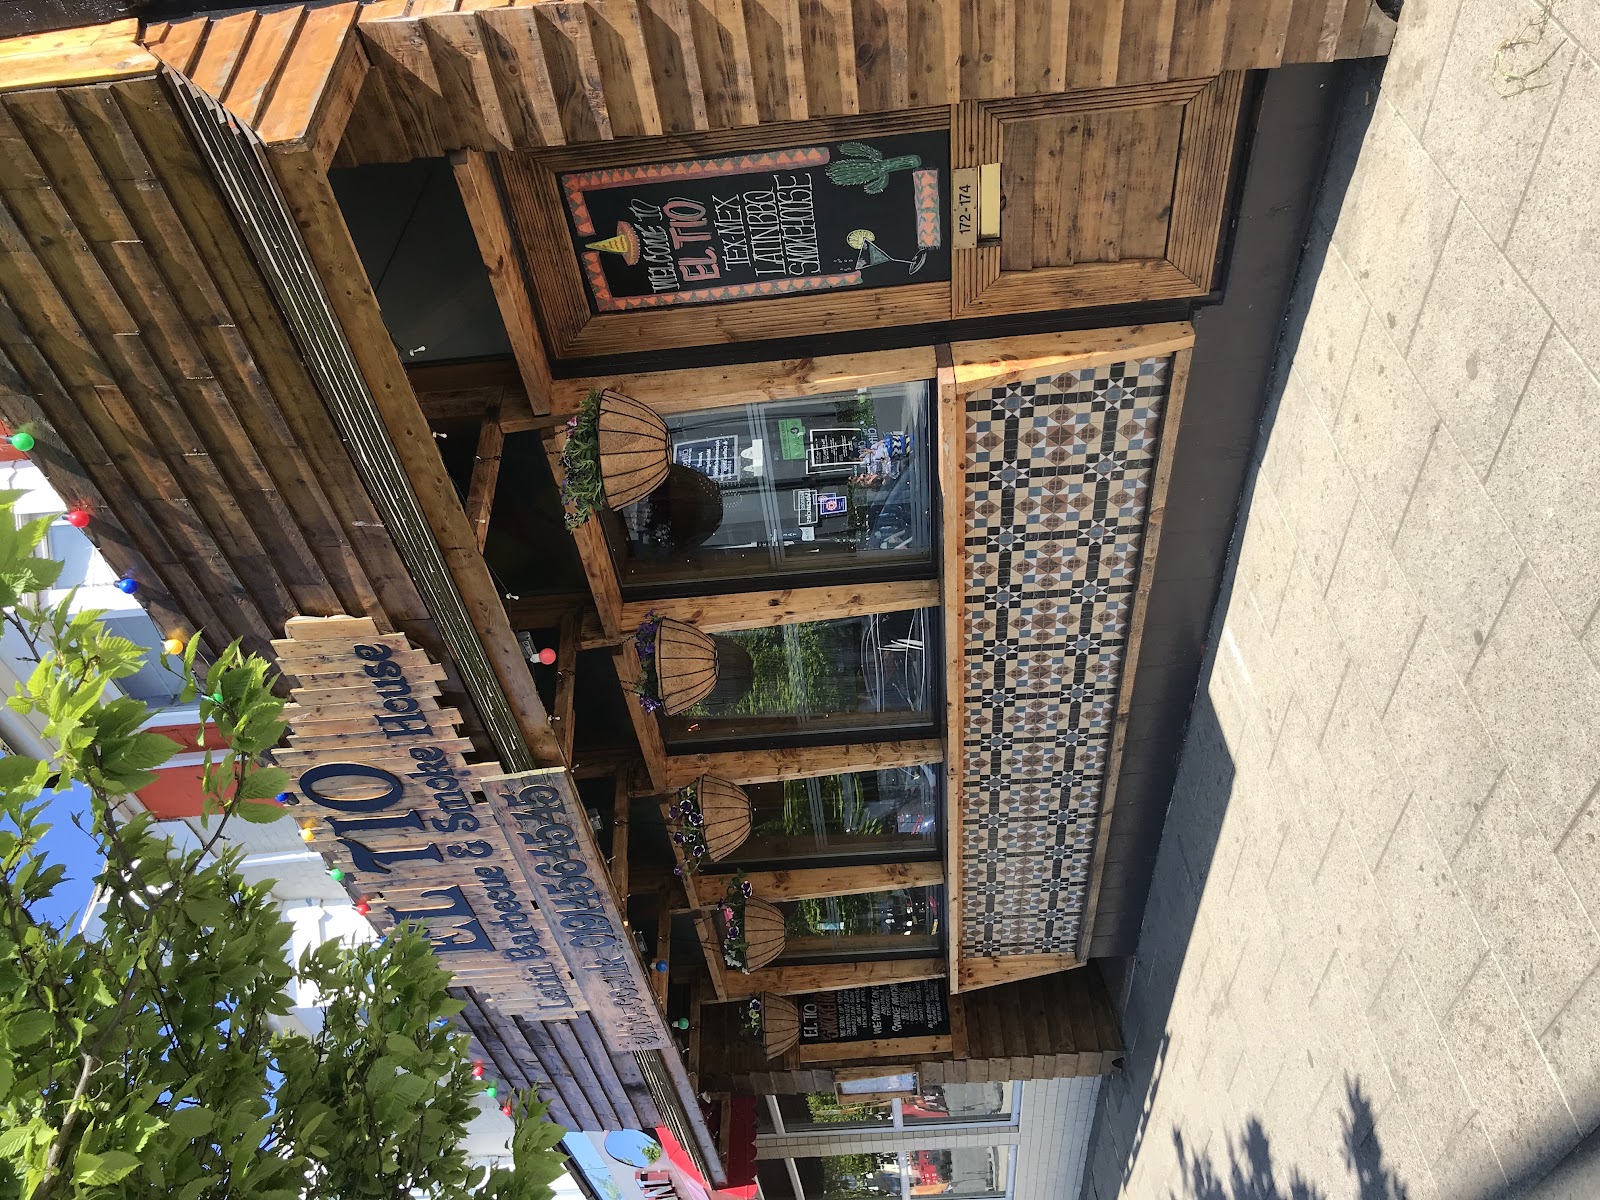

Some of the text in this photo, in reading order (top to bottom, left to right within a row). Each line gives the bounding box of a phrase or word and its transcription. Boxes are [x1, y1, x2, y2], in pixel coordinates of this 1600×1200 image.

[627, 198, 680, 293] WELCOME TO
[662, 196, 721, 281] EL TIO
[712, 193, 751, 271] TEX-MEX
[773, 172, 821, 275] SMOKEHOUSE
[958, 184, 971, 235] 172-174
[298, 763, 495, 951] EL TIO
[353, 643, 573, 1010] Latin Barbecue & Smoke House
[802, 1003, 819, 1037] EL TIO
